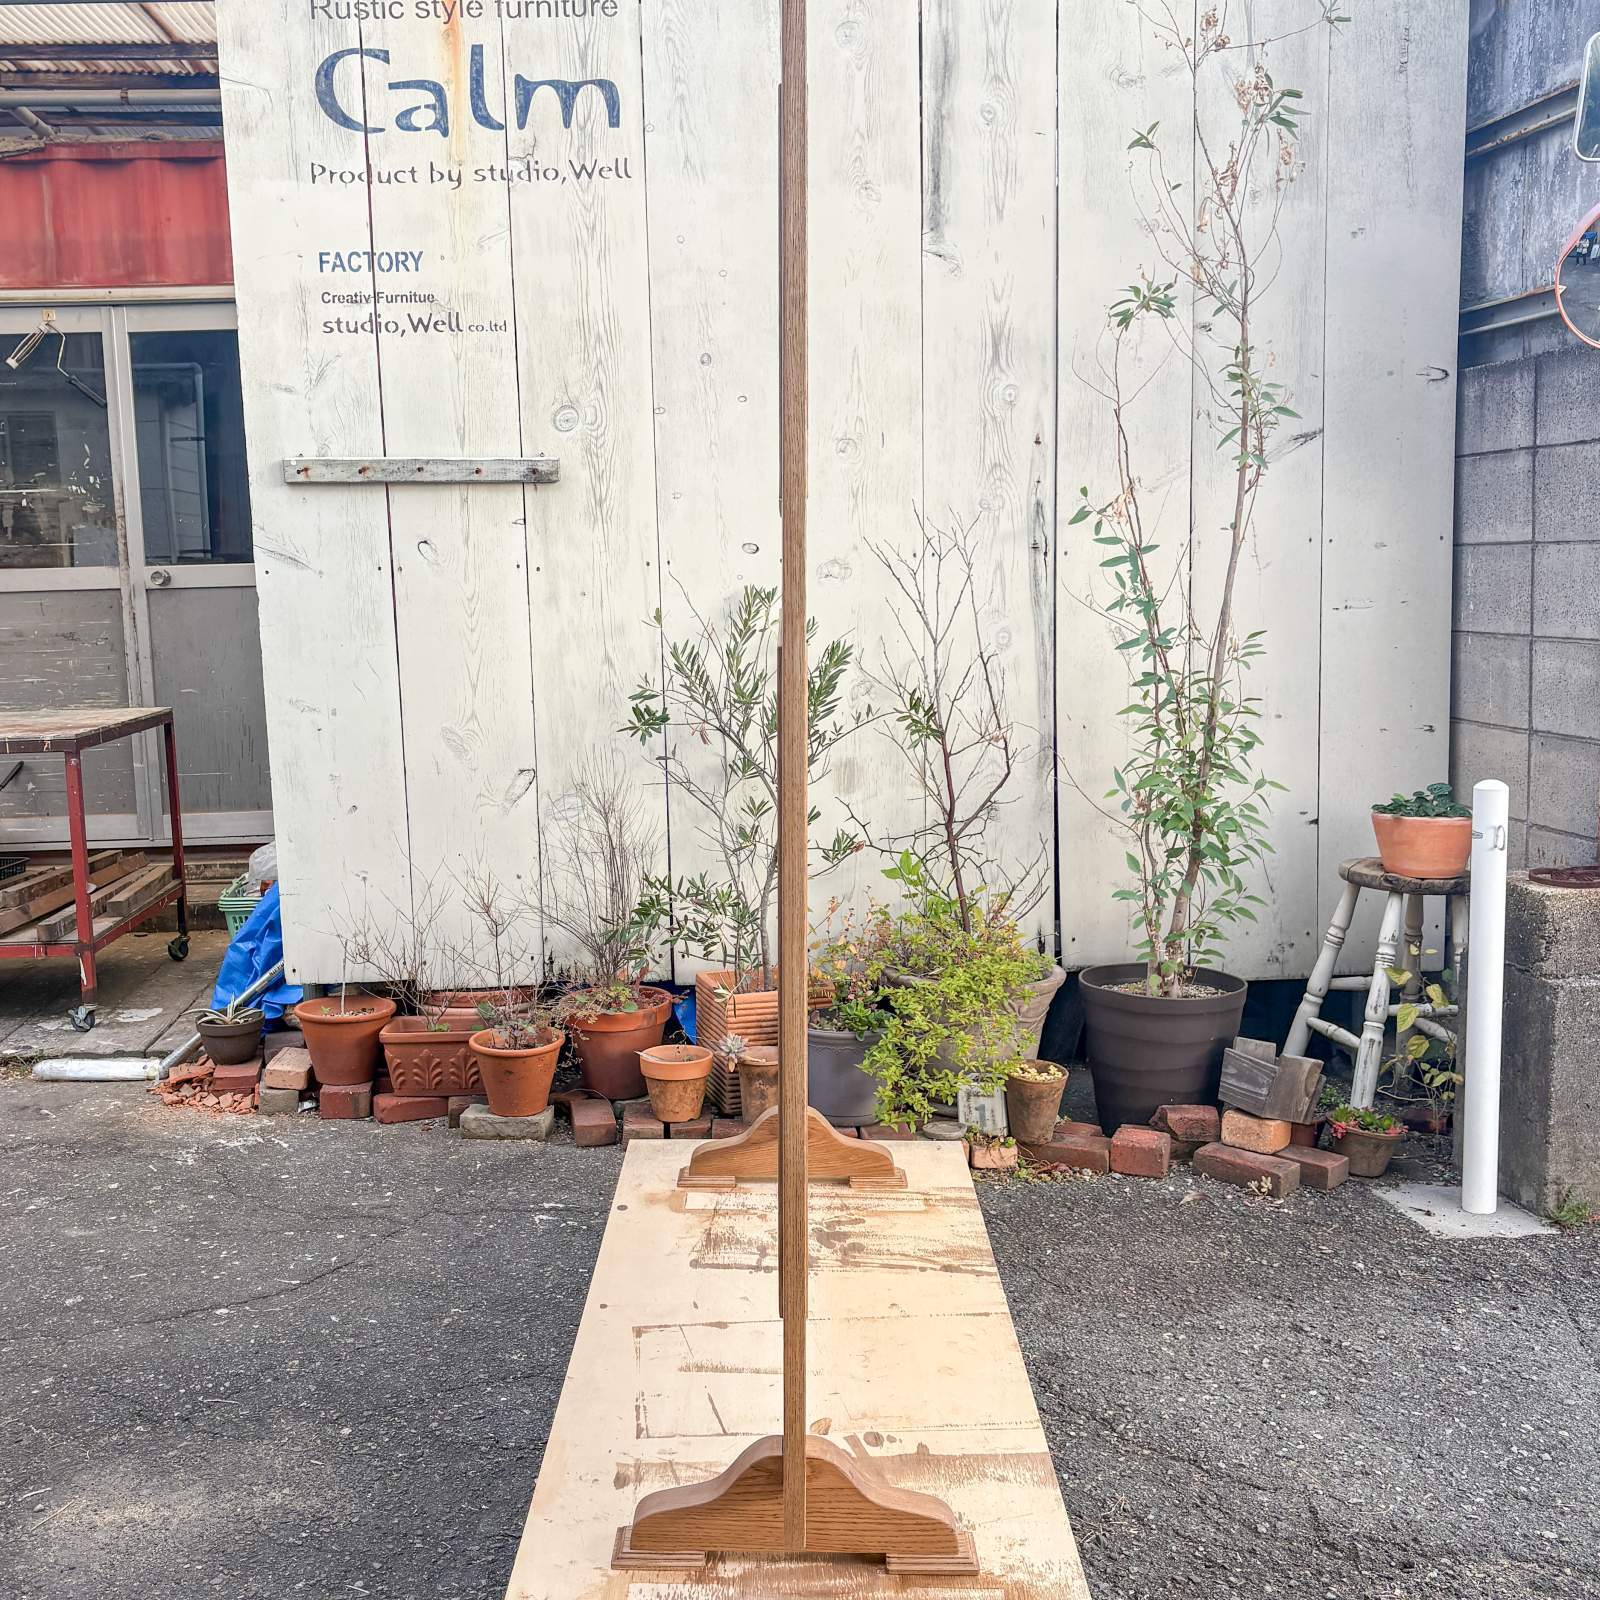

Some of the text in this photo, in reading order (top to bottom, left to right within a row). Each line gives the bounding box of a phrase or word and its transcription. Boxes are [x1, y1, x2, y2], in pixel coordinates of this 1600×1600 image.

[310, 0, 618, 25] Rustic style furniture
[314, 44, 621, 138] Calm
[310, 161, 419, 185] Product
[429, 160, 463, 191] by
[318, 250, 424, 273] FACTORY
